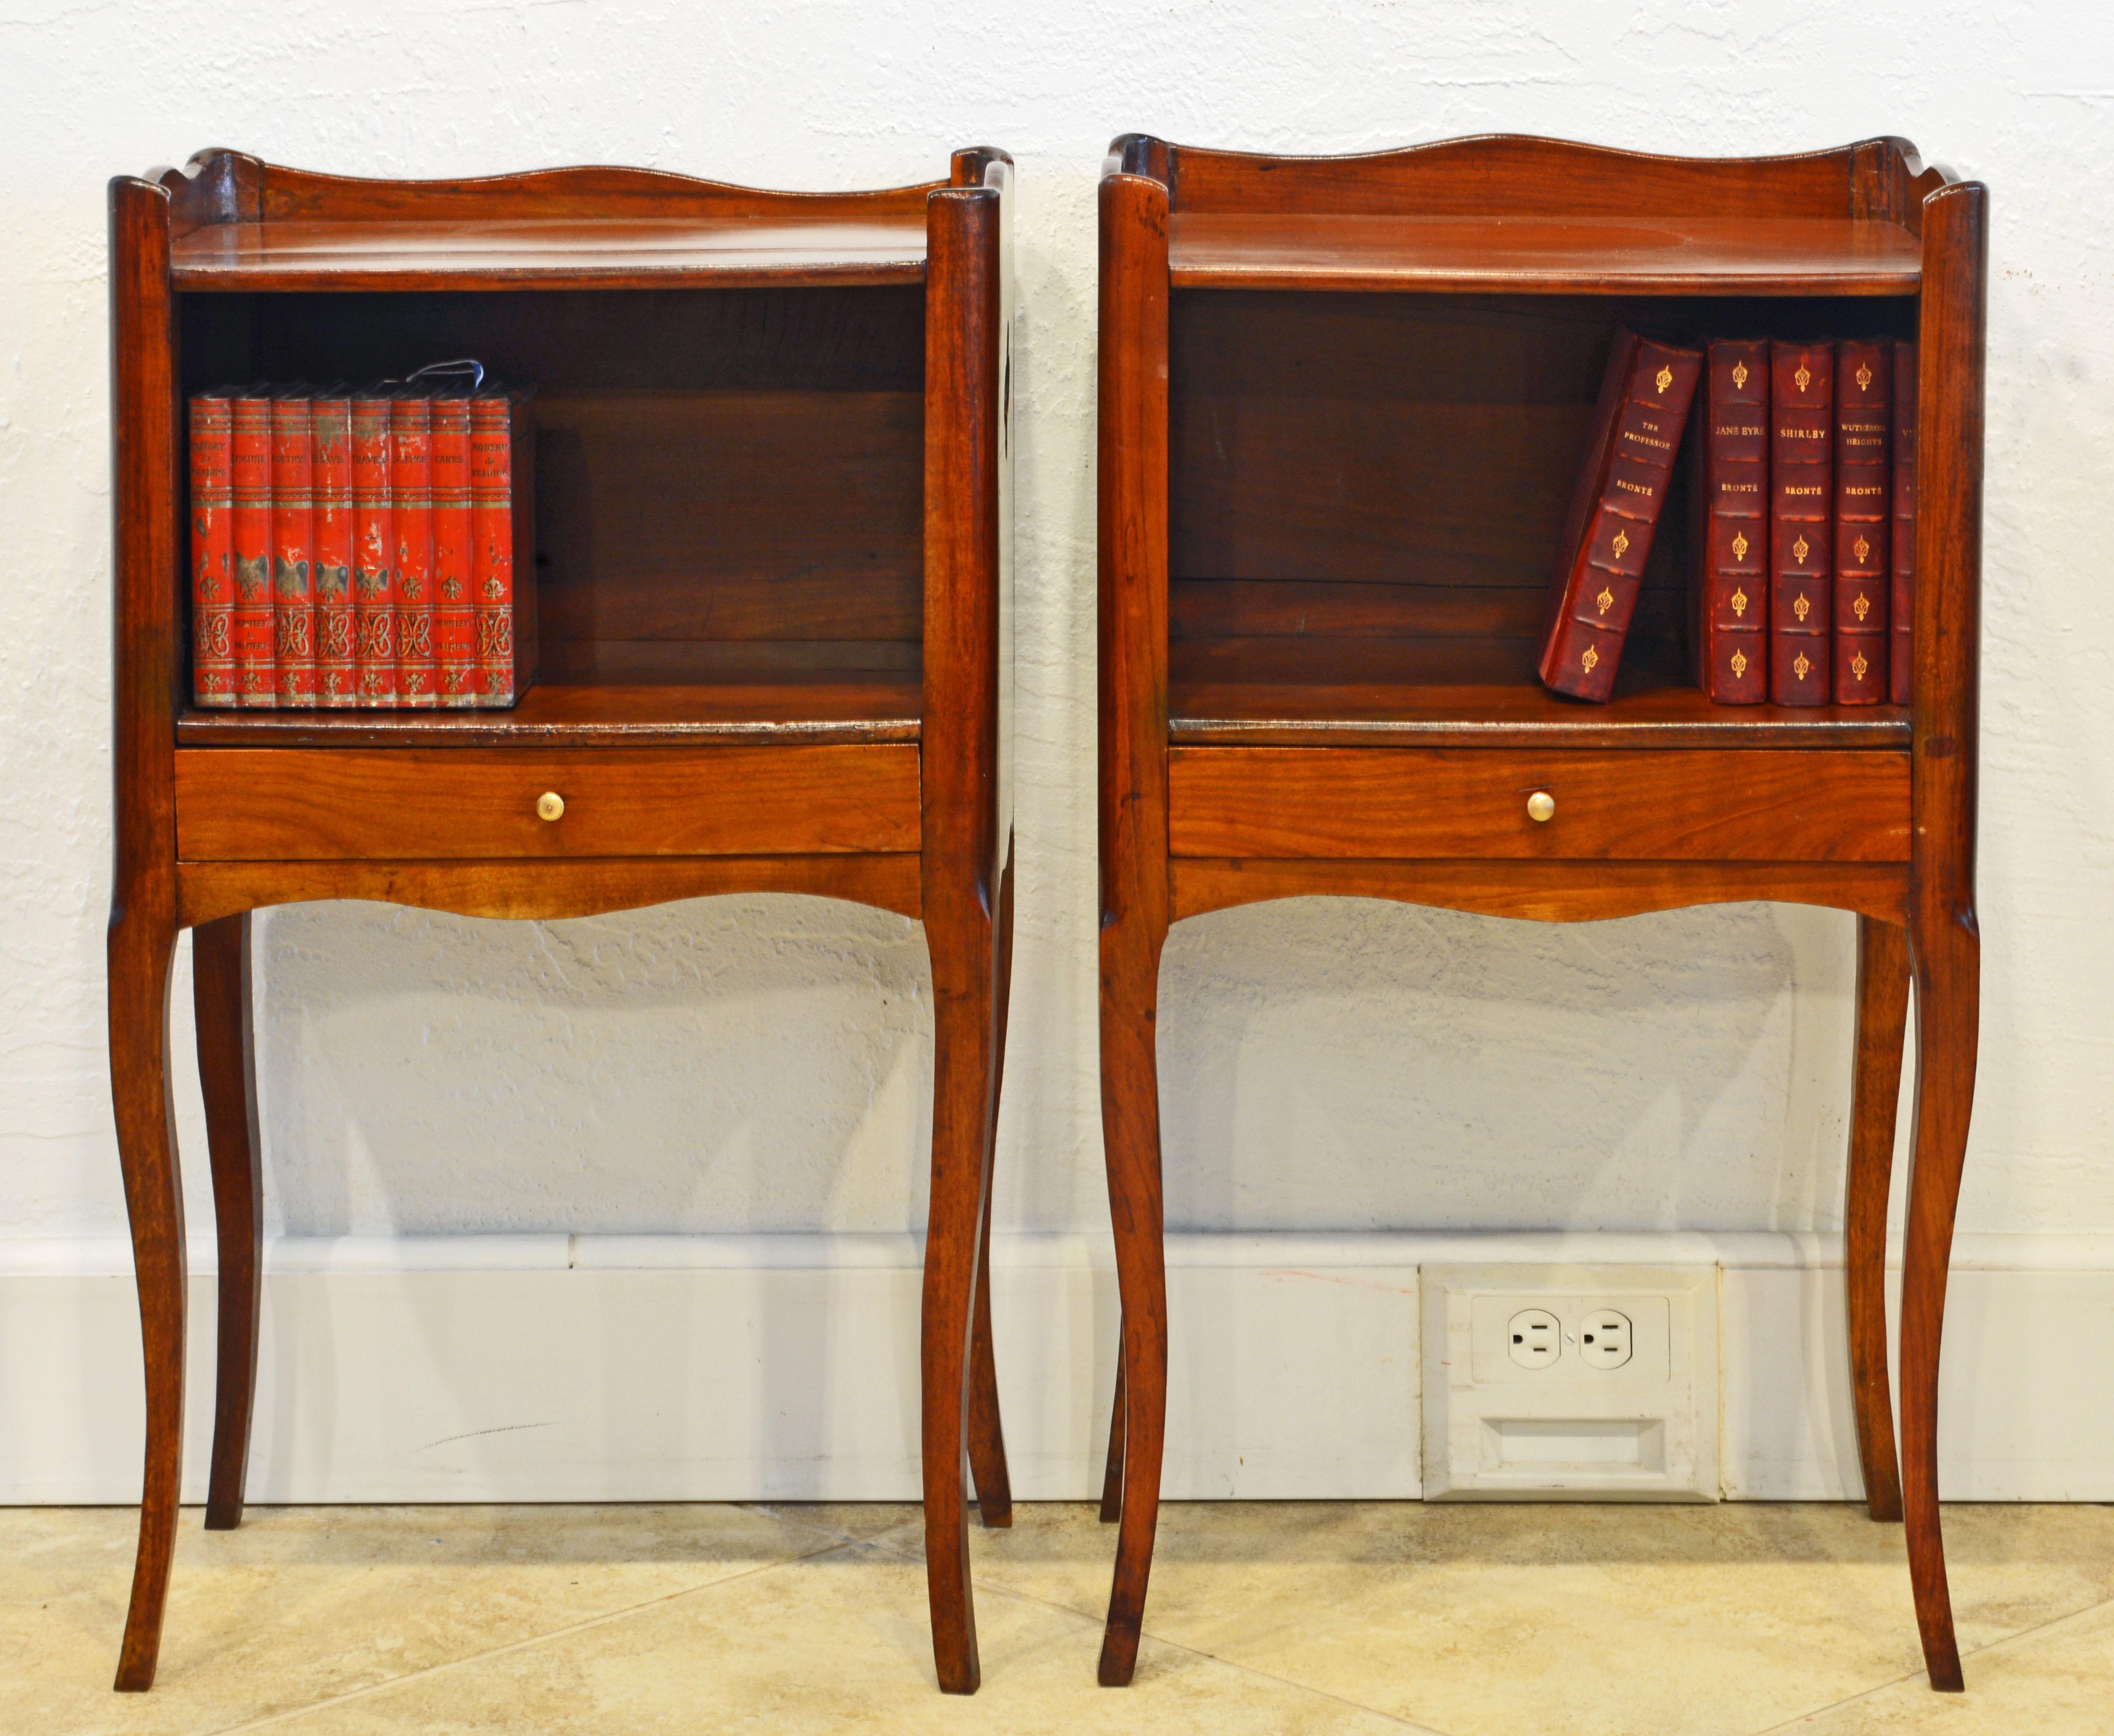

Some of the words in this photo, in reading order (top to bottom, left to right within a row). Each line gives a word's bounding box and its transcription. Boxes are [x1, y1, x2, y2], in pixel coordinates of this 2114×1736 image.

[1643, 422, 1658, 432] THE
[1716, 427, 1739, 435] JANE
[1742, 427, 1764, 435] EYRE
[1781, 429, 1825, 438] SHIRLEY
[1624, 431, 1671, 450] PROFESSOR
[272, 455, 305, 463] POETRY
[393, 455, 427, 463] SCIENCE
[435, 455, 464, 463] CAKES
